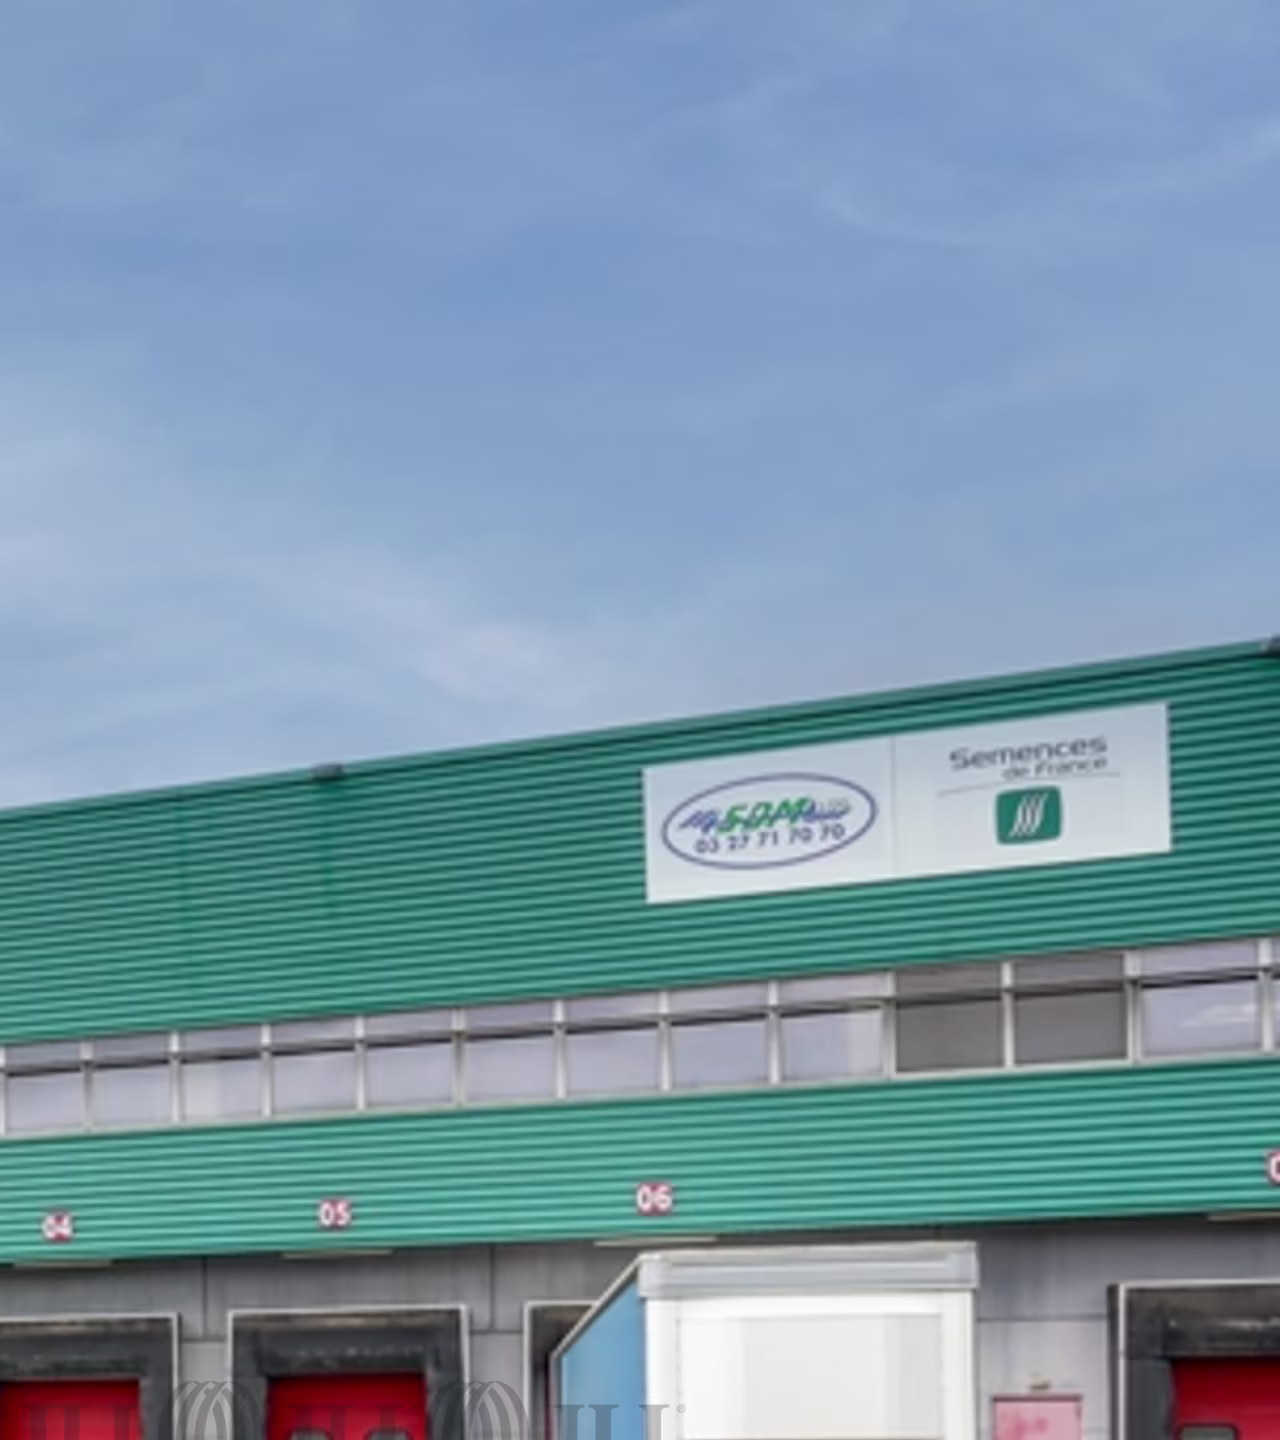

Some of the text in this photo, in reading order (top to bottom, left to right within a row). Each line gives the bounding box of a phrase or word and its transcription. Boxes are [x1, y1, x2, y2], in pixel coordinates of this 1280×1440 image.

[949, 735, 1108, 771] Semences
[1002, 757, 1108, 781] de France
[694, 837, 719, 854] 03
[637, 1185, 673, 1212] 06
[320, 1200, 350, 1227] 05
